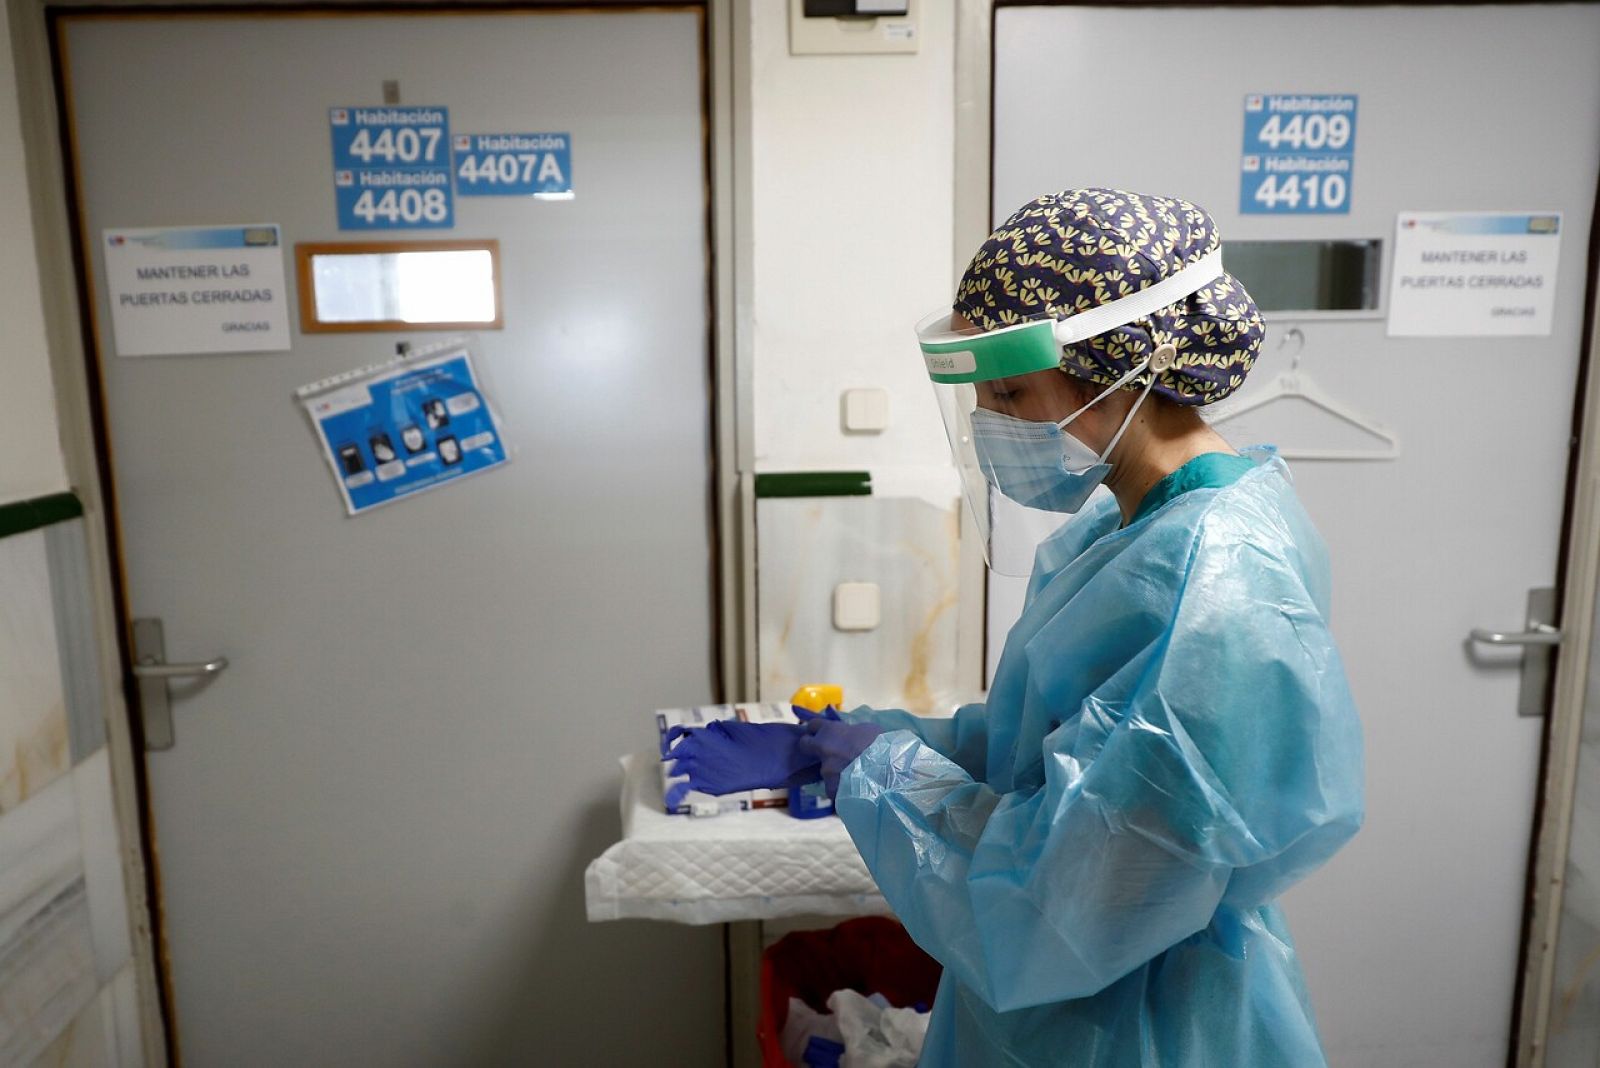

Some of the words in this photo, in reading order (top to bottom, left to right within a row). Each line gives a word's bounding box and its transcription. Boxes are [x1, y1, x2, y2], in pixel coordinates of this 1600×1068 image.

[355, 109, 443, 125] Habitación
[1258, 114, 1351, 149] 4409
[350, 127, 442, 163] 4407
[477, 135, 565, 151] Habitación
[459, 153, 564, 184] 4407A
[360, 170, 447, 186] Habitación
[1255, 174, 1346, 209] 4410
[353, 188, 447, 222] 4408
[1421, 251, 1498, 264] MANTENER
[1501, 250, 1528, 264] LAS
[137, 265, 218, 280] MANTENER
[221, 264, 249, 277] LAS
[1400, 274, 1465, 288] PUERTAS
[1468, 274, 1544, 289] CERRADAS
[120, 291, 187, 306] PUERTAS
[191, 289, 272, 305] CERRADAS
[222, 321, 270, 333] GRACIAS
